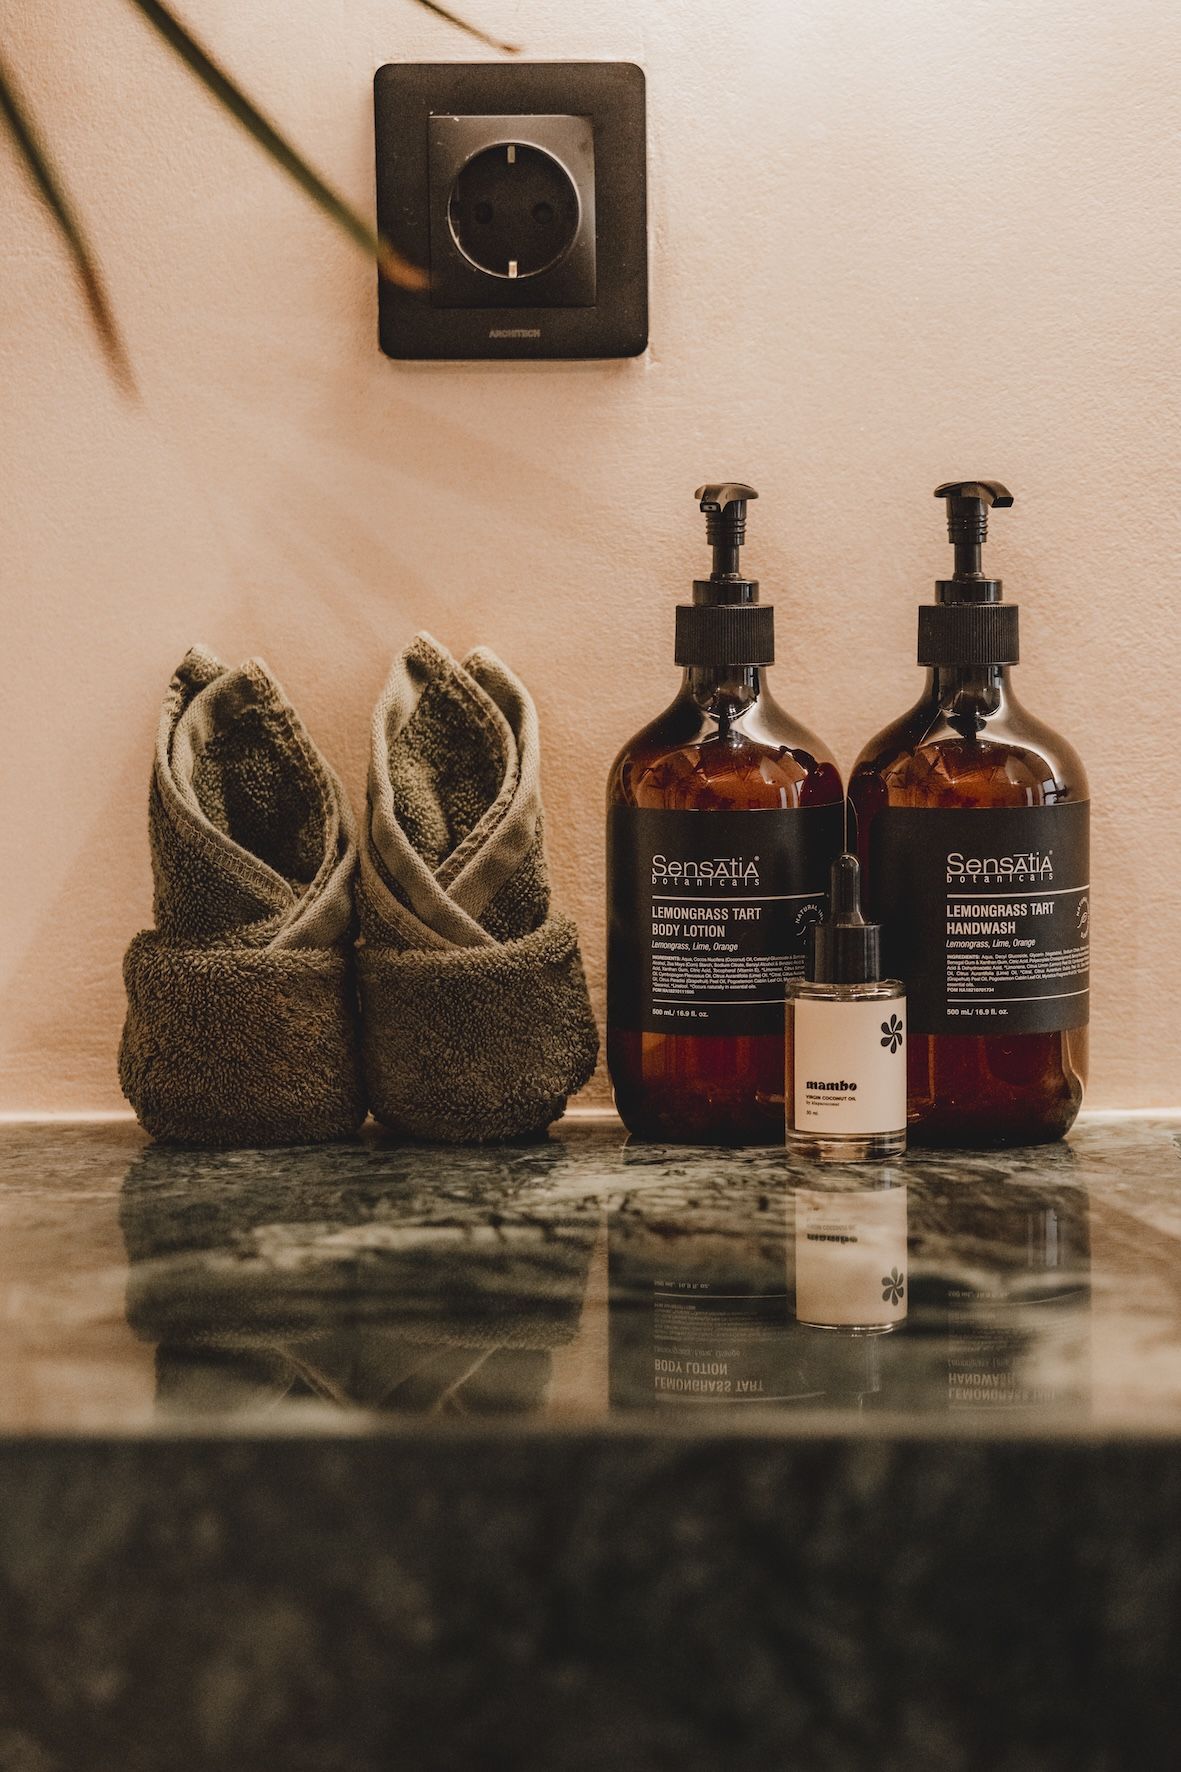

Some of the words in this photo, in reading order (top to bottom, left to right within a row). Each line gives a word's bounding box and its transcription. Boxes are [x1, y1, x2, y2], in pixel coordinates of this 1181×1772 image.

[652, 875, 760, 887] botanicals
[947, 873, 1053, 883] botanicals
[652, 906, 728, 921] LEMONGRASS
[732, 907, 762, 920] TART
[947, 903, 1027, 918] LEMONGRASS
[1030, 902, 1054, 915] TART
[652, 924, 679, 937] BODY
[684, 925, 725, 937] LOTION
[947, 922, 1015, 935] HANDWASH
[652, 941, 690, 952] Lemongrass,
[692, 942, 711, 952] Lime,
[713, 942, 738, 952] Orange
[946, 940, 990, 949] Lemongrass,
[993, 939, 1010, 949] Lime,
[1013, 939, 1036, 948] Orange
[806, 1080, 857, 1091] mambo
